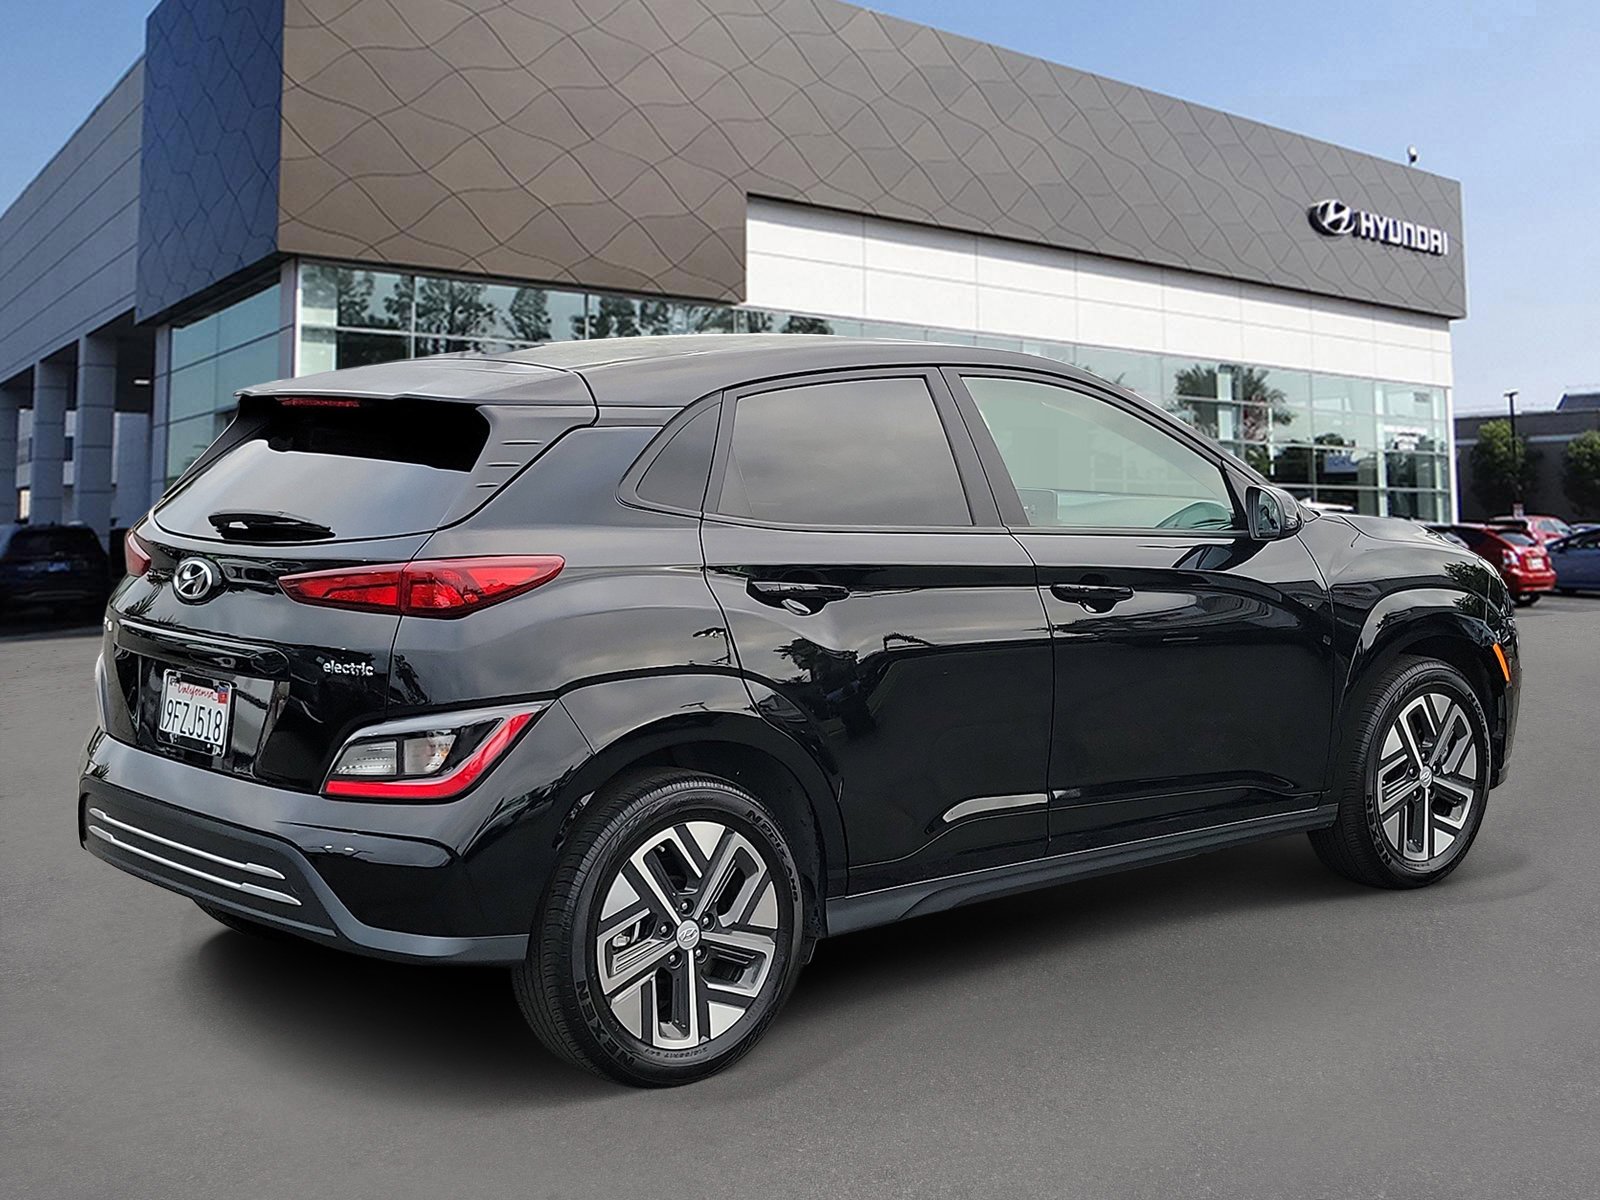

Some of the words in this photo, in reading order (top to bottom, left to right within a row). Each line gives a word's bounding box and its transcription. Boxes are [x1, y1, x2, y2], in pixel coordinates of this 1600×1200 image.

[1360, 211, 1448, 256] HYUNDAI
[322, 660, 374, 676] electric
[164, 698, 223, 742] 9FZJ518
